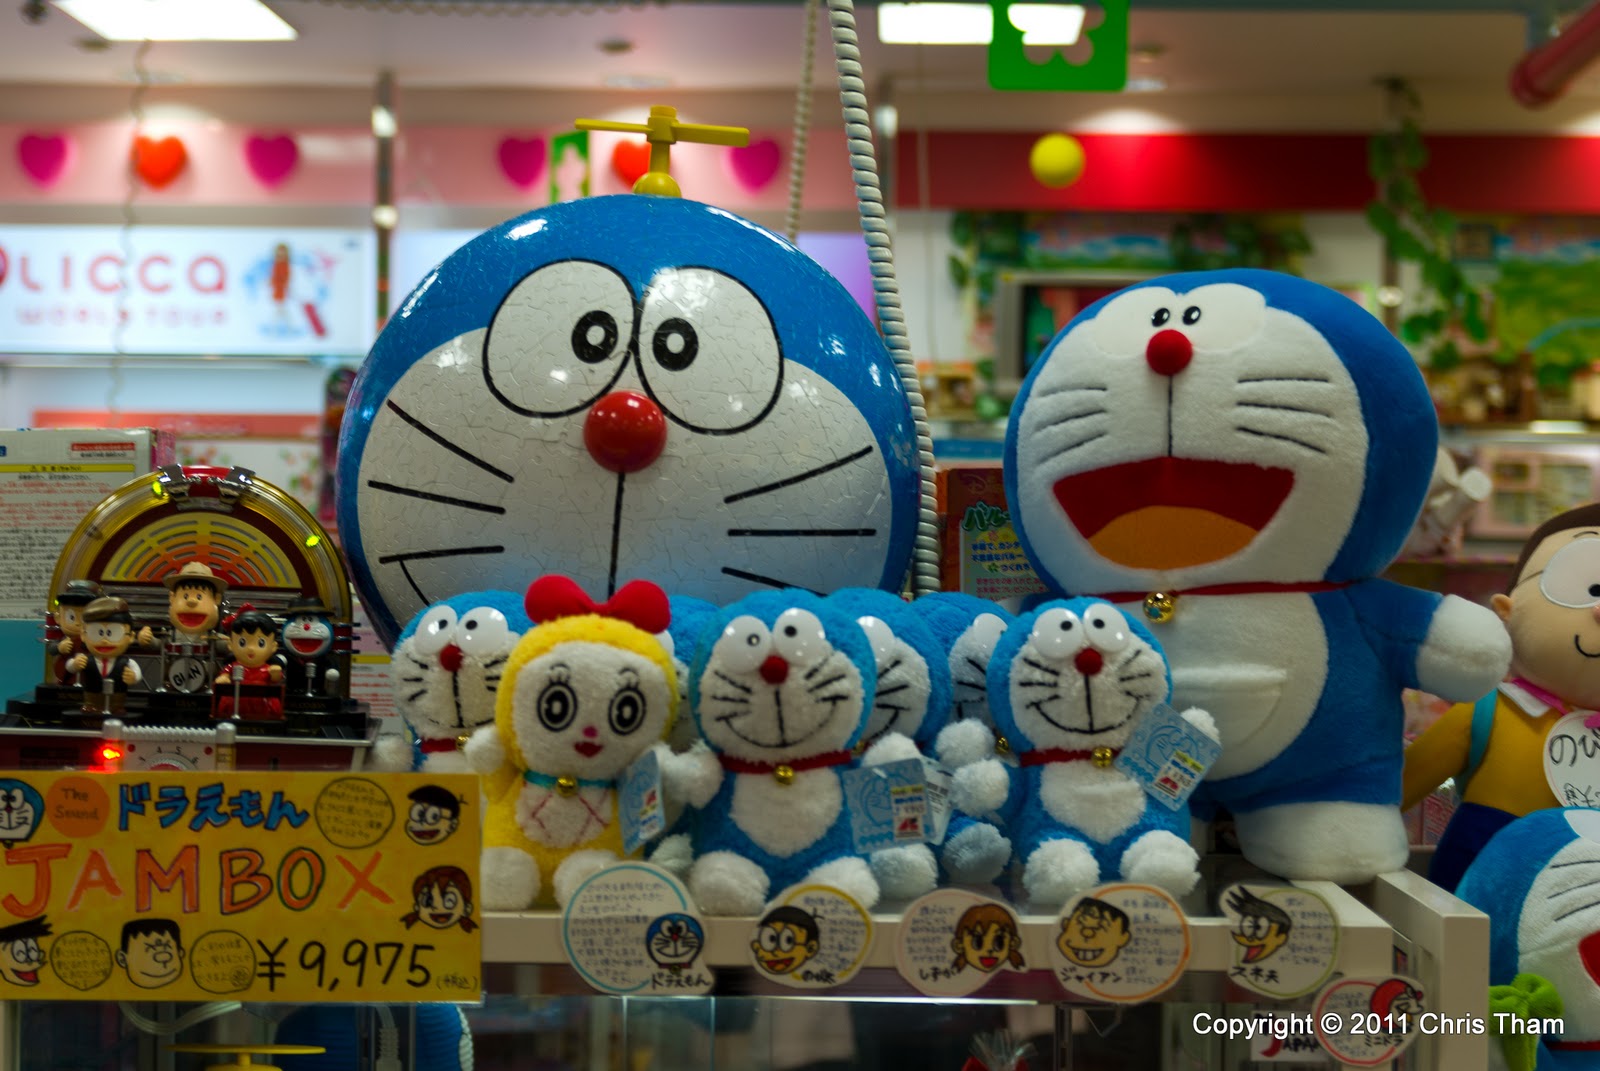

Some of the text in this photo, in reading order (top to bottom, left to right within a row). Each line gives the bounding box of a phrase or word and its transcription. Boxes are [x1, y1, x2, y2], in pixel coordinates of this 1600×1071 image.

[61, 787, 89, 802] The
[53, 806, 100, 821] Sound
[118, 782, 310, 831] ドラえもん
[1060, 966, 1122, 983] ジャイアン
